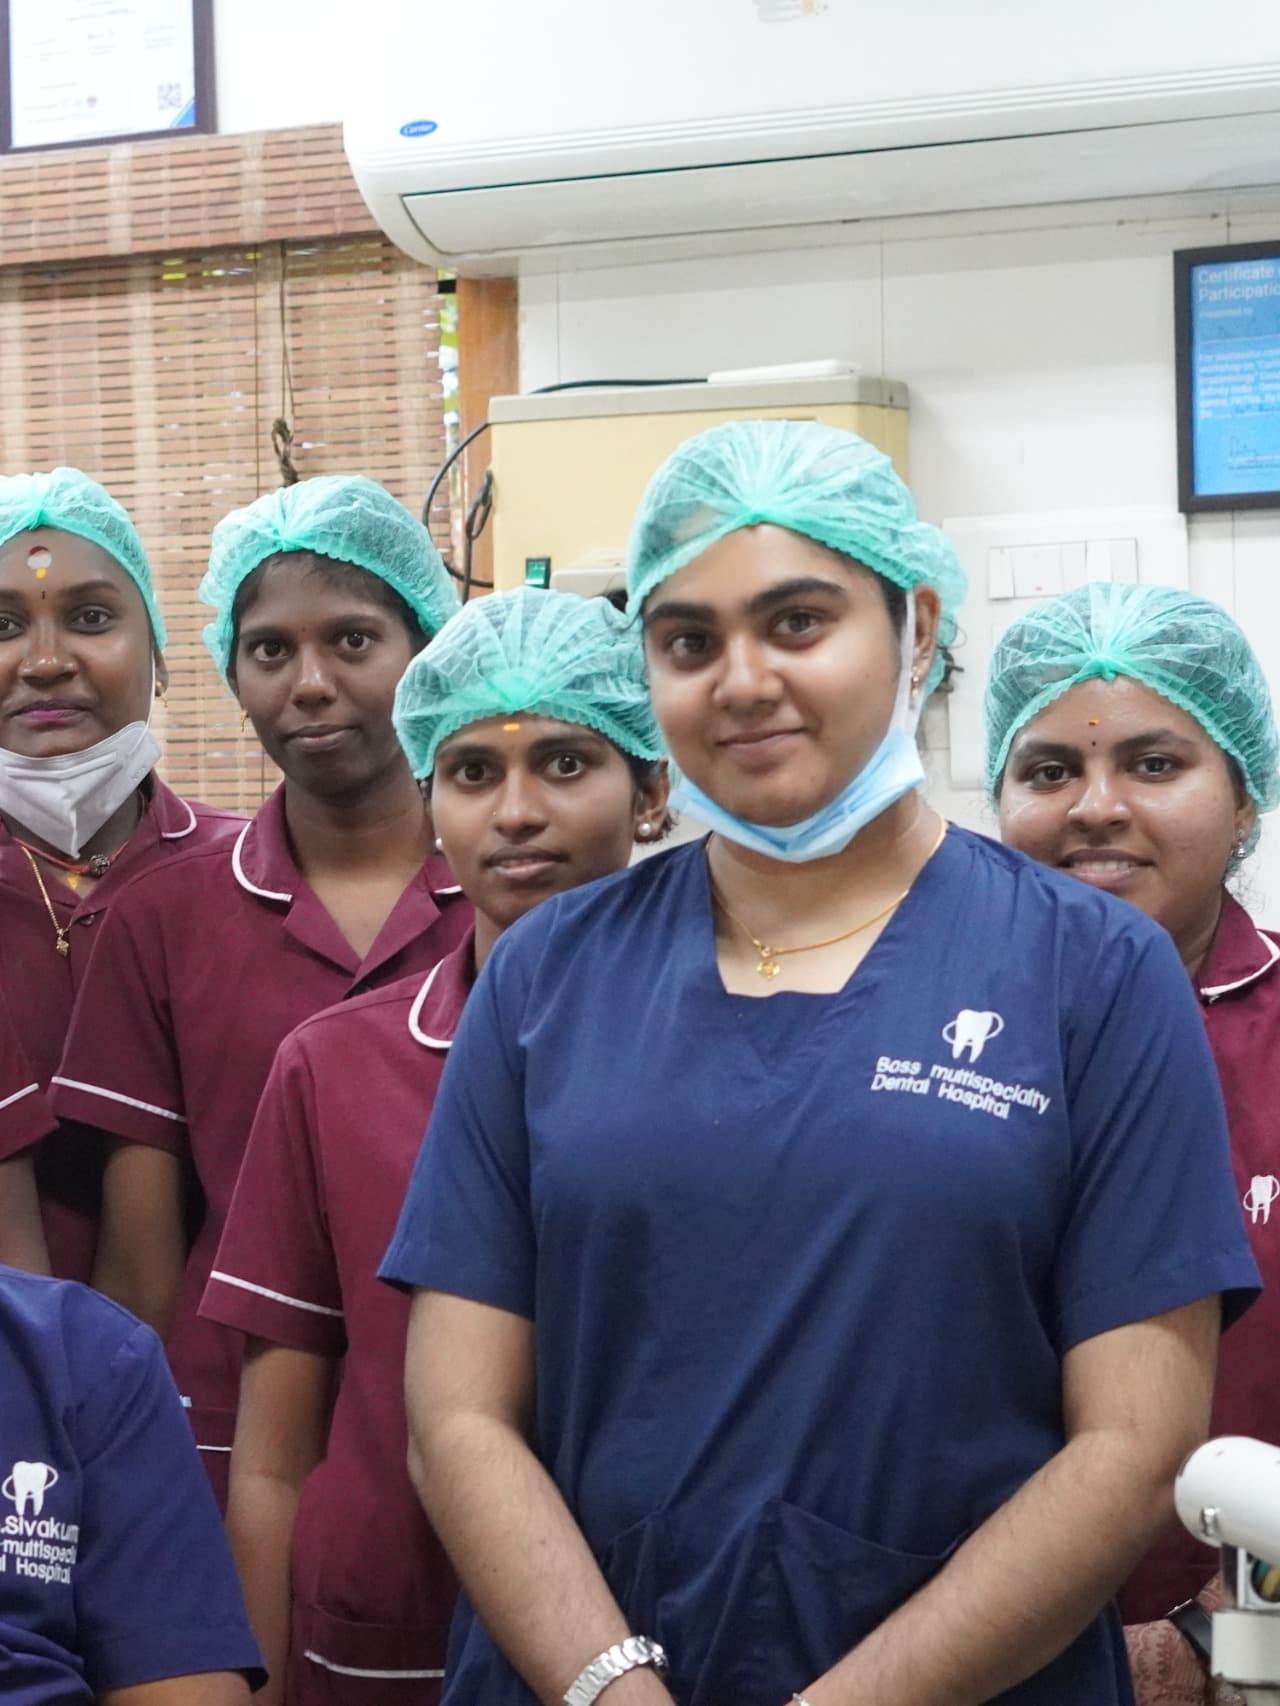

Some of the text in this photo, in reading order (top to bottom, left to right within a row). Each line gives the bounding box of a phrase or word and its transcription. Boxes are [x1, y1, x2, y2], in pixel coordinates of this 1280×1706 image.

[871, 1074, 1011, 1120] Dental Hospital
[930, 1063, 1051, 1115] multispecialty
[16, 1557, 71, 1584] Hospital
